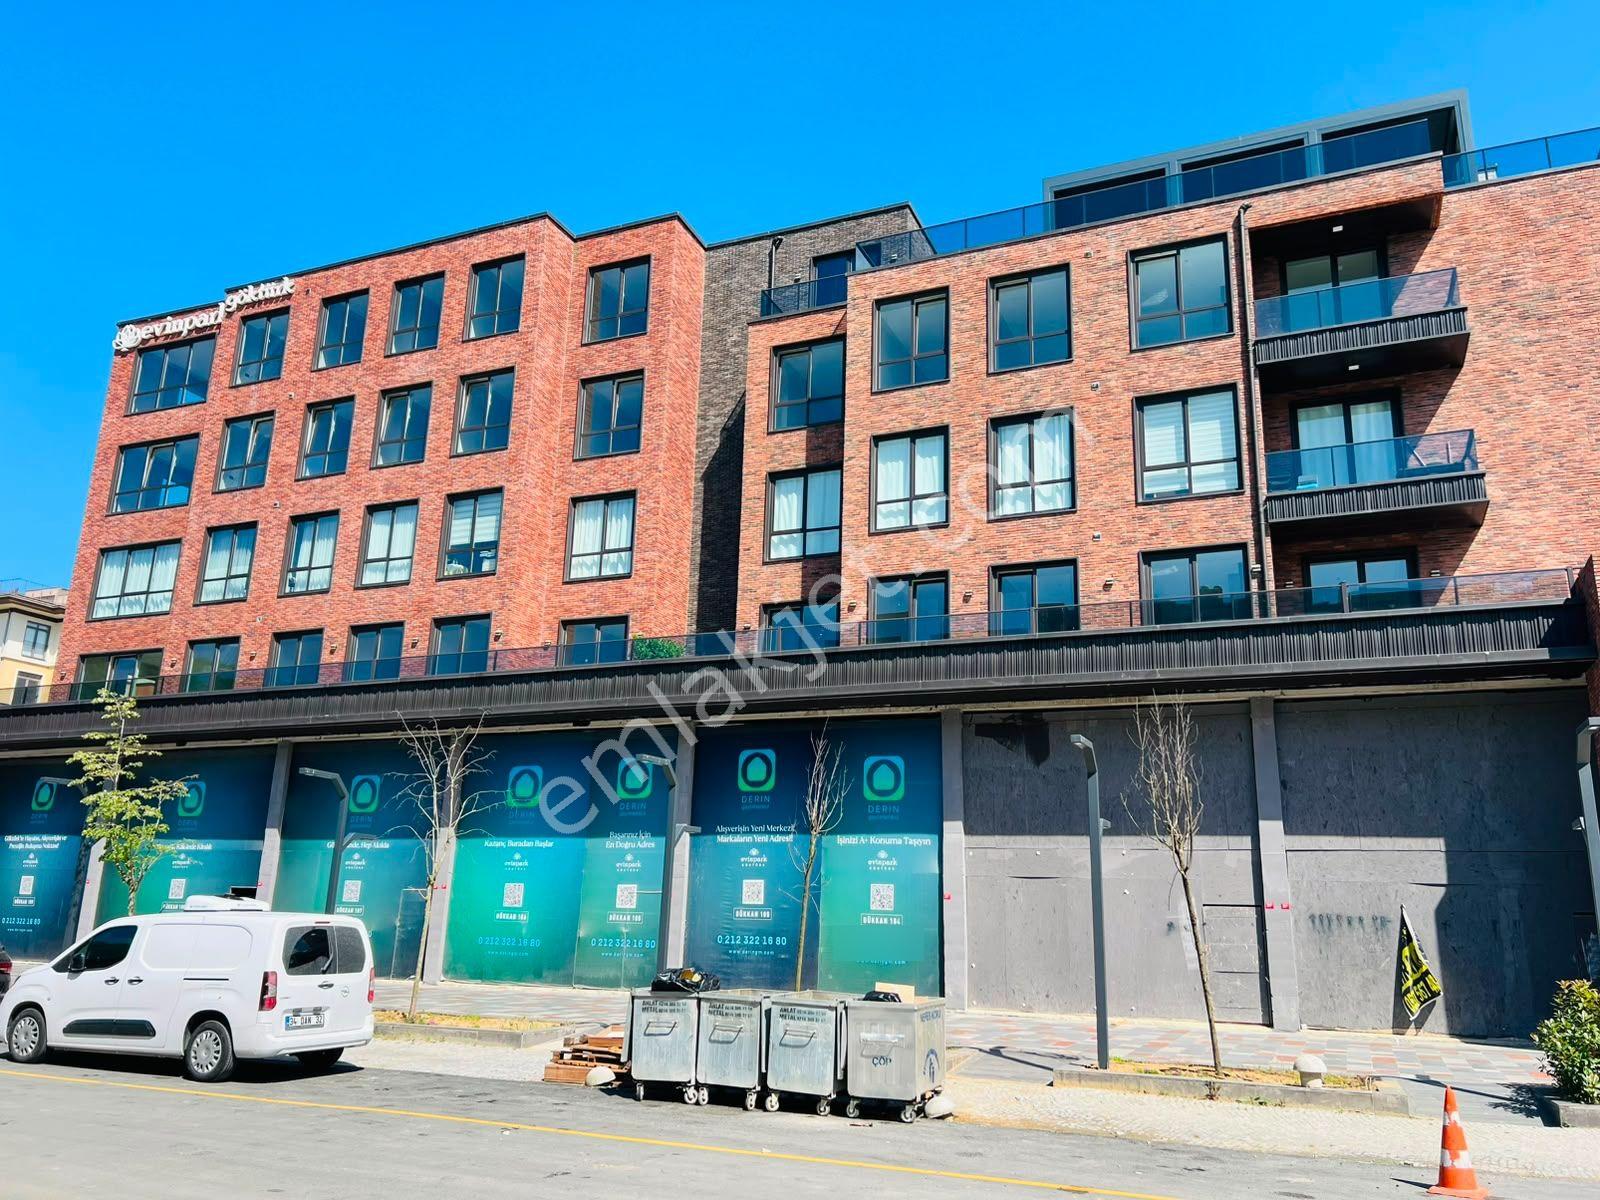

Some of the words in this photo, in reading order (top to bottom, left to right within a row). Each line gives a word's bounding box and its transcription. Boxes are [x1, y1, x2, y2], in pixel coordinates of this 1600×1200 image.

[507, 839, 534, 847] Buradan
[870, 836, 903, 845] Konuma
[478, 936, 483, 945] 0
[485, 937, 499, 945] 212
[501, 937, 516, 946] 322
[591, 938, 596, 947] 0
[598, 938, 613, 947] 212
[615, 938, 631, 947] 322
[633, 939, 643, 948] 16
[645, 939, 656, 948] 80
[717, 935, 723, 944] 0
[724, 935, 741, 944] 212
[743, 935, 760, 944] 322
[762, 936, 773, 945] 16
[775, 936, 787, 945] 80
[289, 1017, 297, 1025] 34
